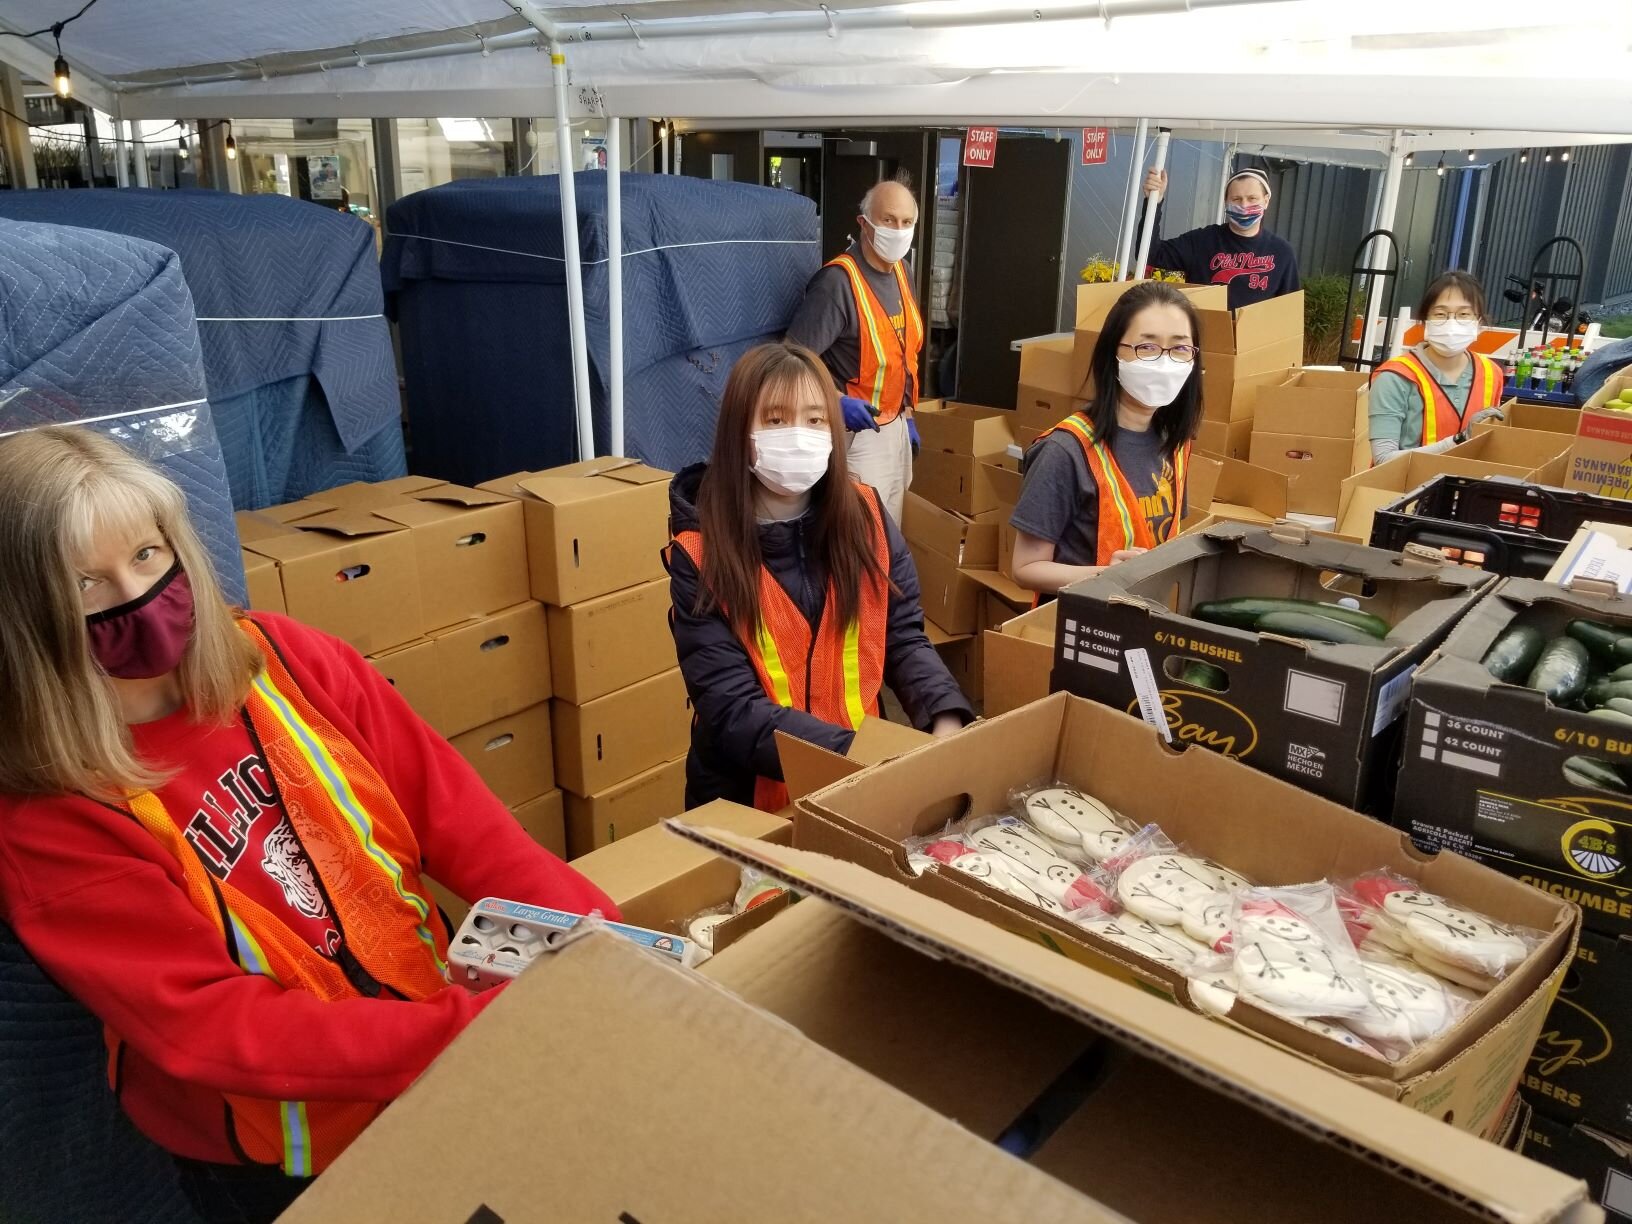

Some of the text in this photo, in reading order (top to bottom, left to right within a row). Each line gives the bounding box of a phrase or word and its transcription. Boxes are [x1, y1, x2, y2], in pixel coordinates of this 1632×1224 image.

[971, 129, 994, 143] STAFF
[1086, 132, 1105, 144] STAFF
[969, 149, 991, 161] ONLY
[1086, 149, 1103, 159] ONLY
[1210, 251, 1276, 271] Old Navy
[1249, 274, 1269, 290] 94
[1574, 457, 1632, 477] BANANAS
[1572, 469, 1630, 490] PREMIUM
[1080, 625, 1121, 642] 36 COUNT
[1079, 640, 1120, 656] 42 COUNT
[1154, 631, 1243, 664] 6/10 BUSHEL
[1446, 719, 1505, 740] 36 COUNT
[1554, 728, 1599, 748] 6/10
[1444, 736, 1502, 757] 42 COUNT
[1287, 754, 1323, 770] HECHO EN
[1578, 835, 1617, 855] 4B's
[512, 905, 541, 922] Large
[540, 909, 570, 925] Grade
